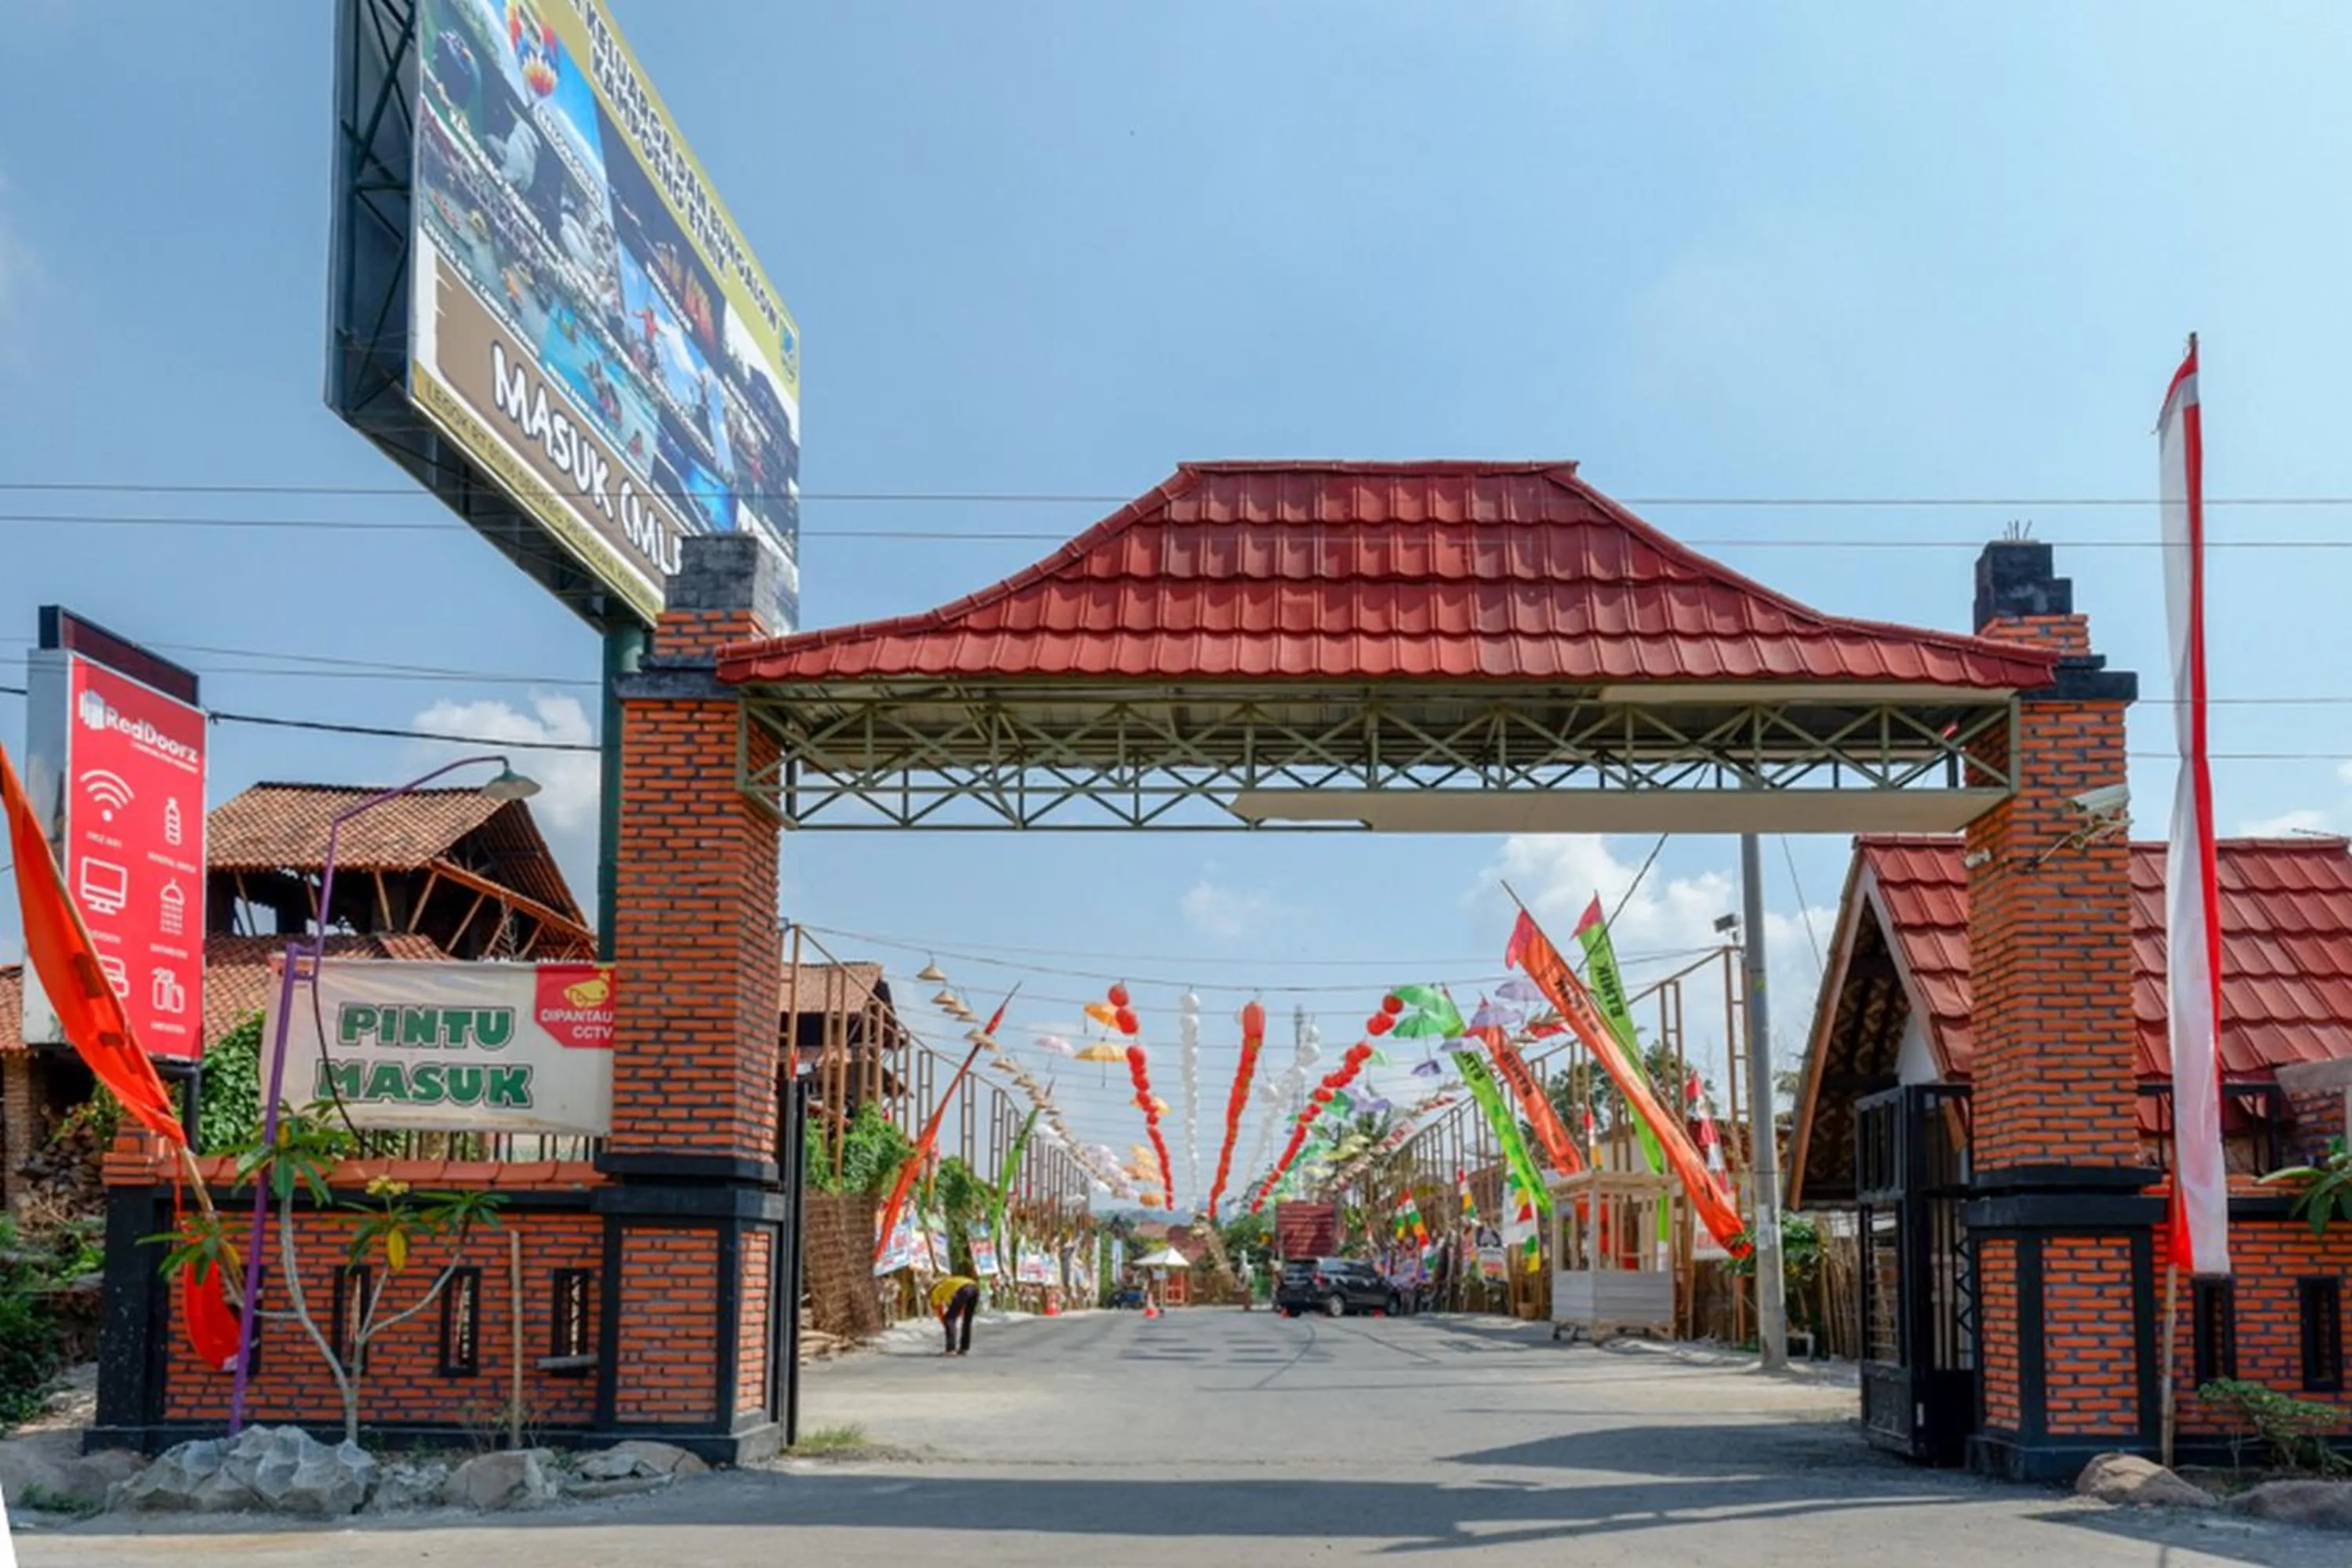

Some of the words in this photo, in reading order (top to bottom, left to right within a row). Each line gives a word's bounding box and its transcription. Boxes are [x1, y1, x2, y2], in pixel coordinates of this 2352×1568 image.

[492, 340, 615, 521] MASUK
[106, 706, 198, 764] RedDoorz
[339, 1003, 515, 1049] PINTU
[541, 1008, 612, 1023] DIPANTAU
[572, 1024, 612, 1040] CCTV
[316, 1060, 534, 1108] MASUK
